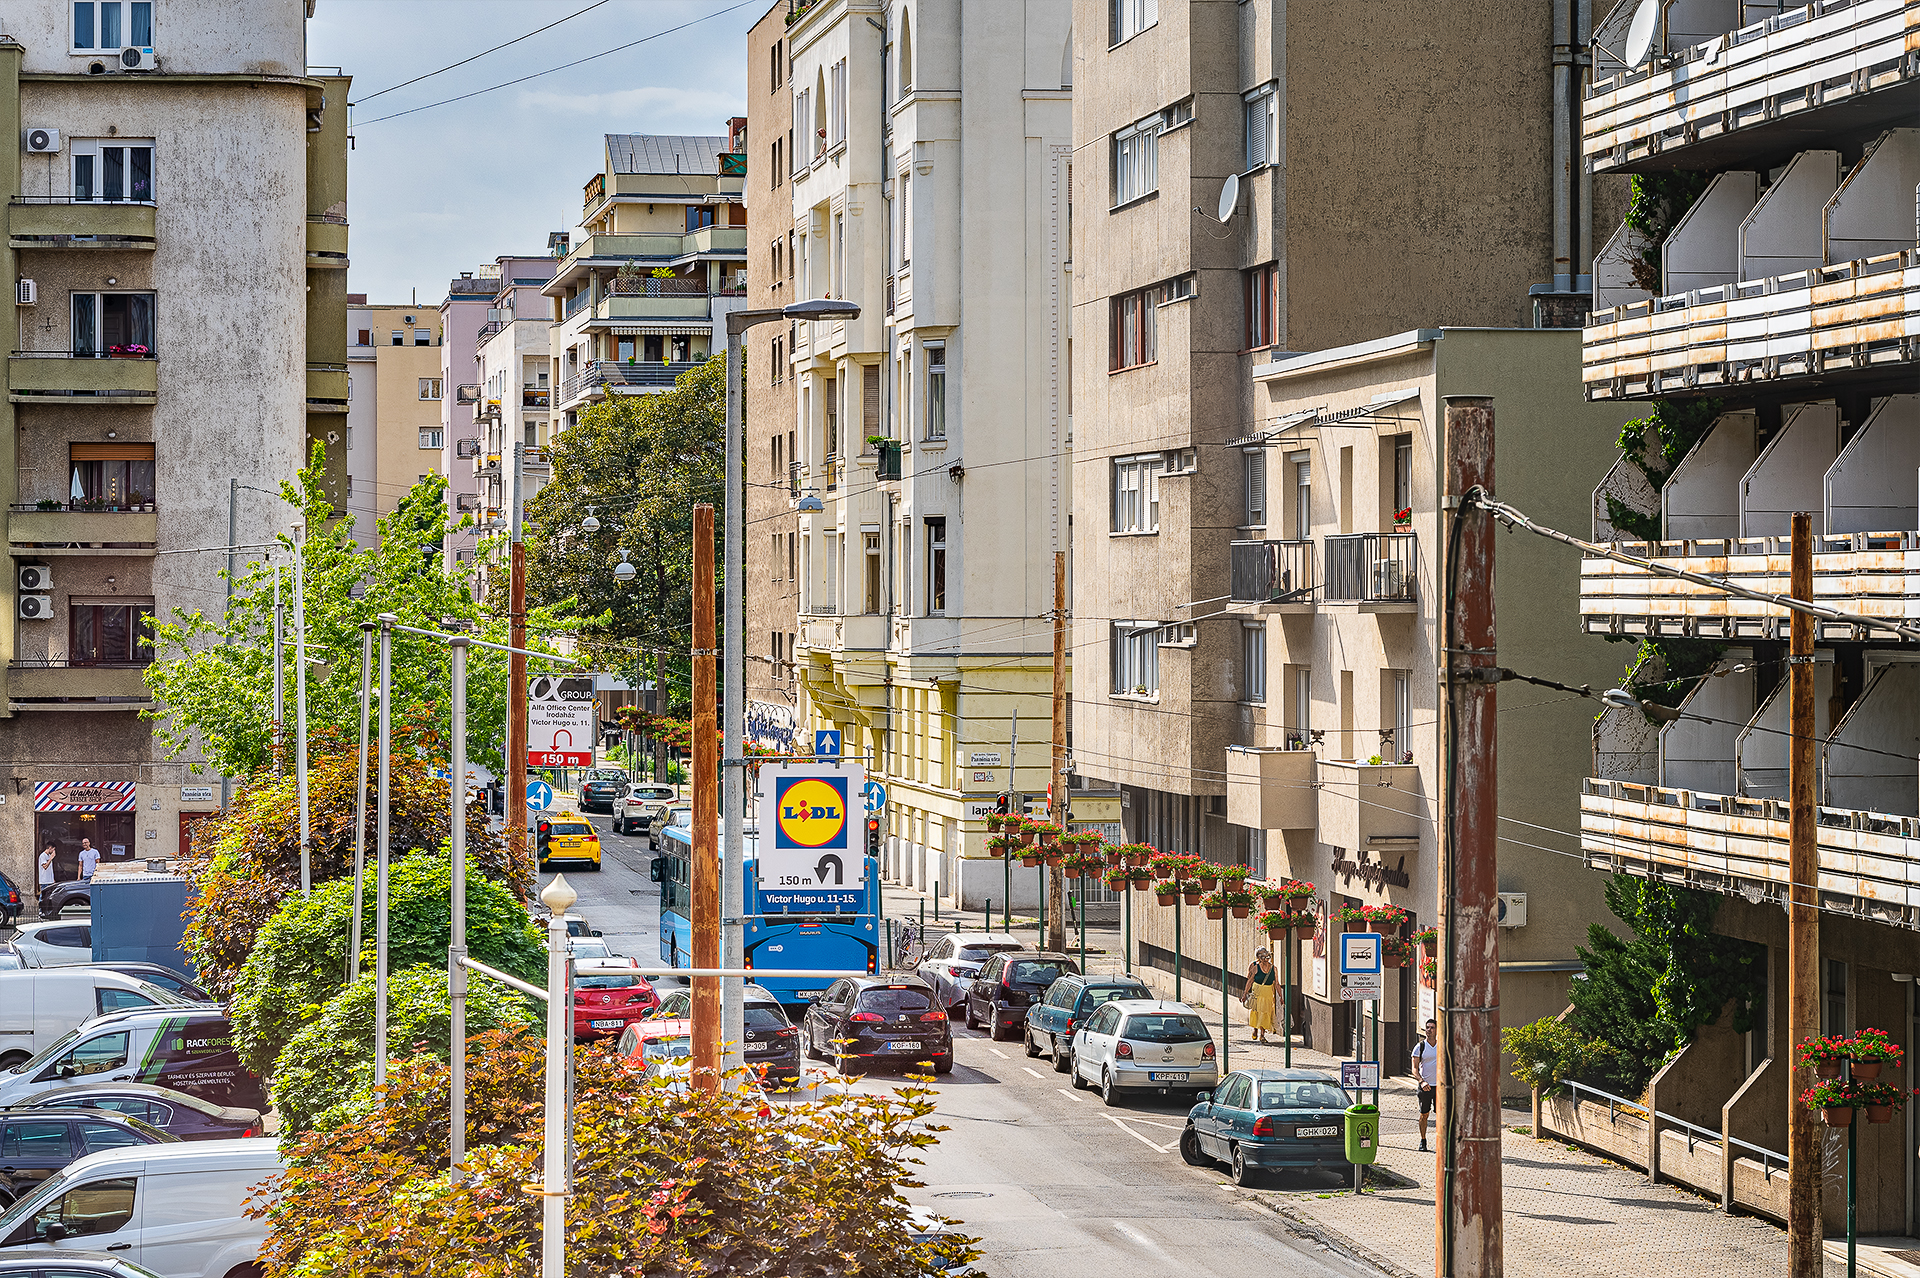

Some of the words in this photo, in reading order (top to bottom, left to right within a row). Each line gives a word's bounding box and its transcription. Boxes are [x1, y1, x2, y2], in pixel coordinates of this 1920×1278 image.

[560, 691, 592, 699] GROUP
[568, 704, 590, 712] Center
[552, 719, 571, 727] Hugo
[540, 753, 564, 764] 150
[567, 756, 579, 764] m
[69, 789, 102, 797] Waikiki
[779, 876, 799, 885] 150
[801, 877, 812, 885] m
[766, 894, 792, 903] Victor
[793, 894, 817, 905] Hugo
[827, 894, 857, 903] 11-15.
[1302, 1127, 1337, 1136] GHK-022
